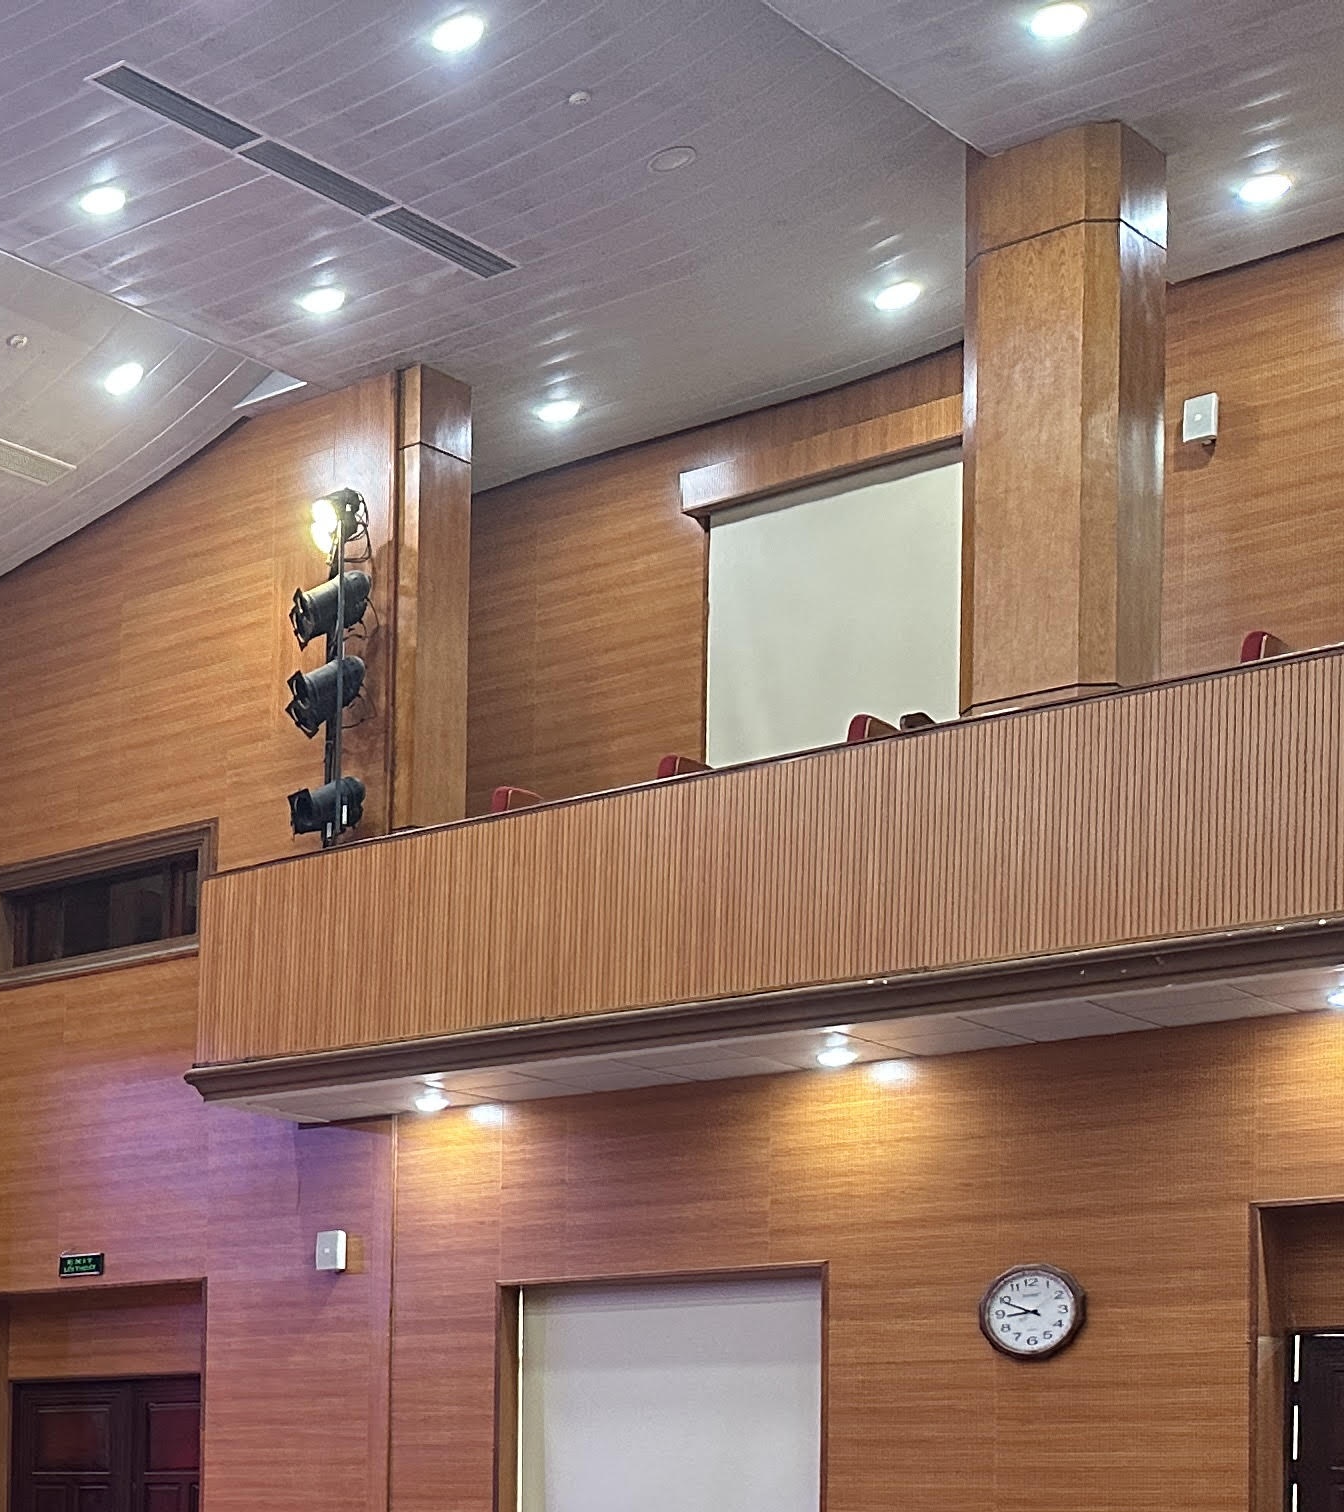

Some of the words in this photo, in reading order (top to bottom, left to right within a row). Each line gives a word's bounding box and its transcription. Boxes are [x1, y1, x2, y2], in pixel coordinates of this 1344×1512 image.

[1010, 1283, 1020, 1292] 11
[1023, 1277, 1039, 1288] 12
[1054, 1290, 1065, 1300] 2
[1057, 1304, 1068, 1314] 3
[995, 1310, 1006, 1320] 9
[1000, 1324, 1011, 1333] 8
[1053, 1319, 1064, 1328] 4
[1013, 1332, 1022, 1342] 7
[1026, 1336, 1038, 1346] 6
